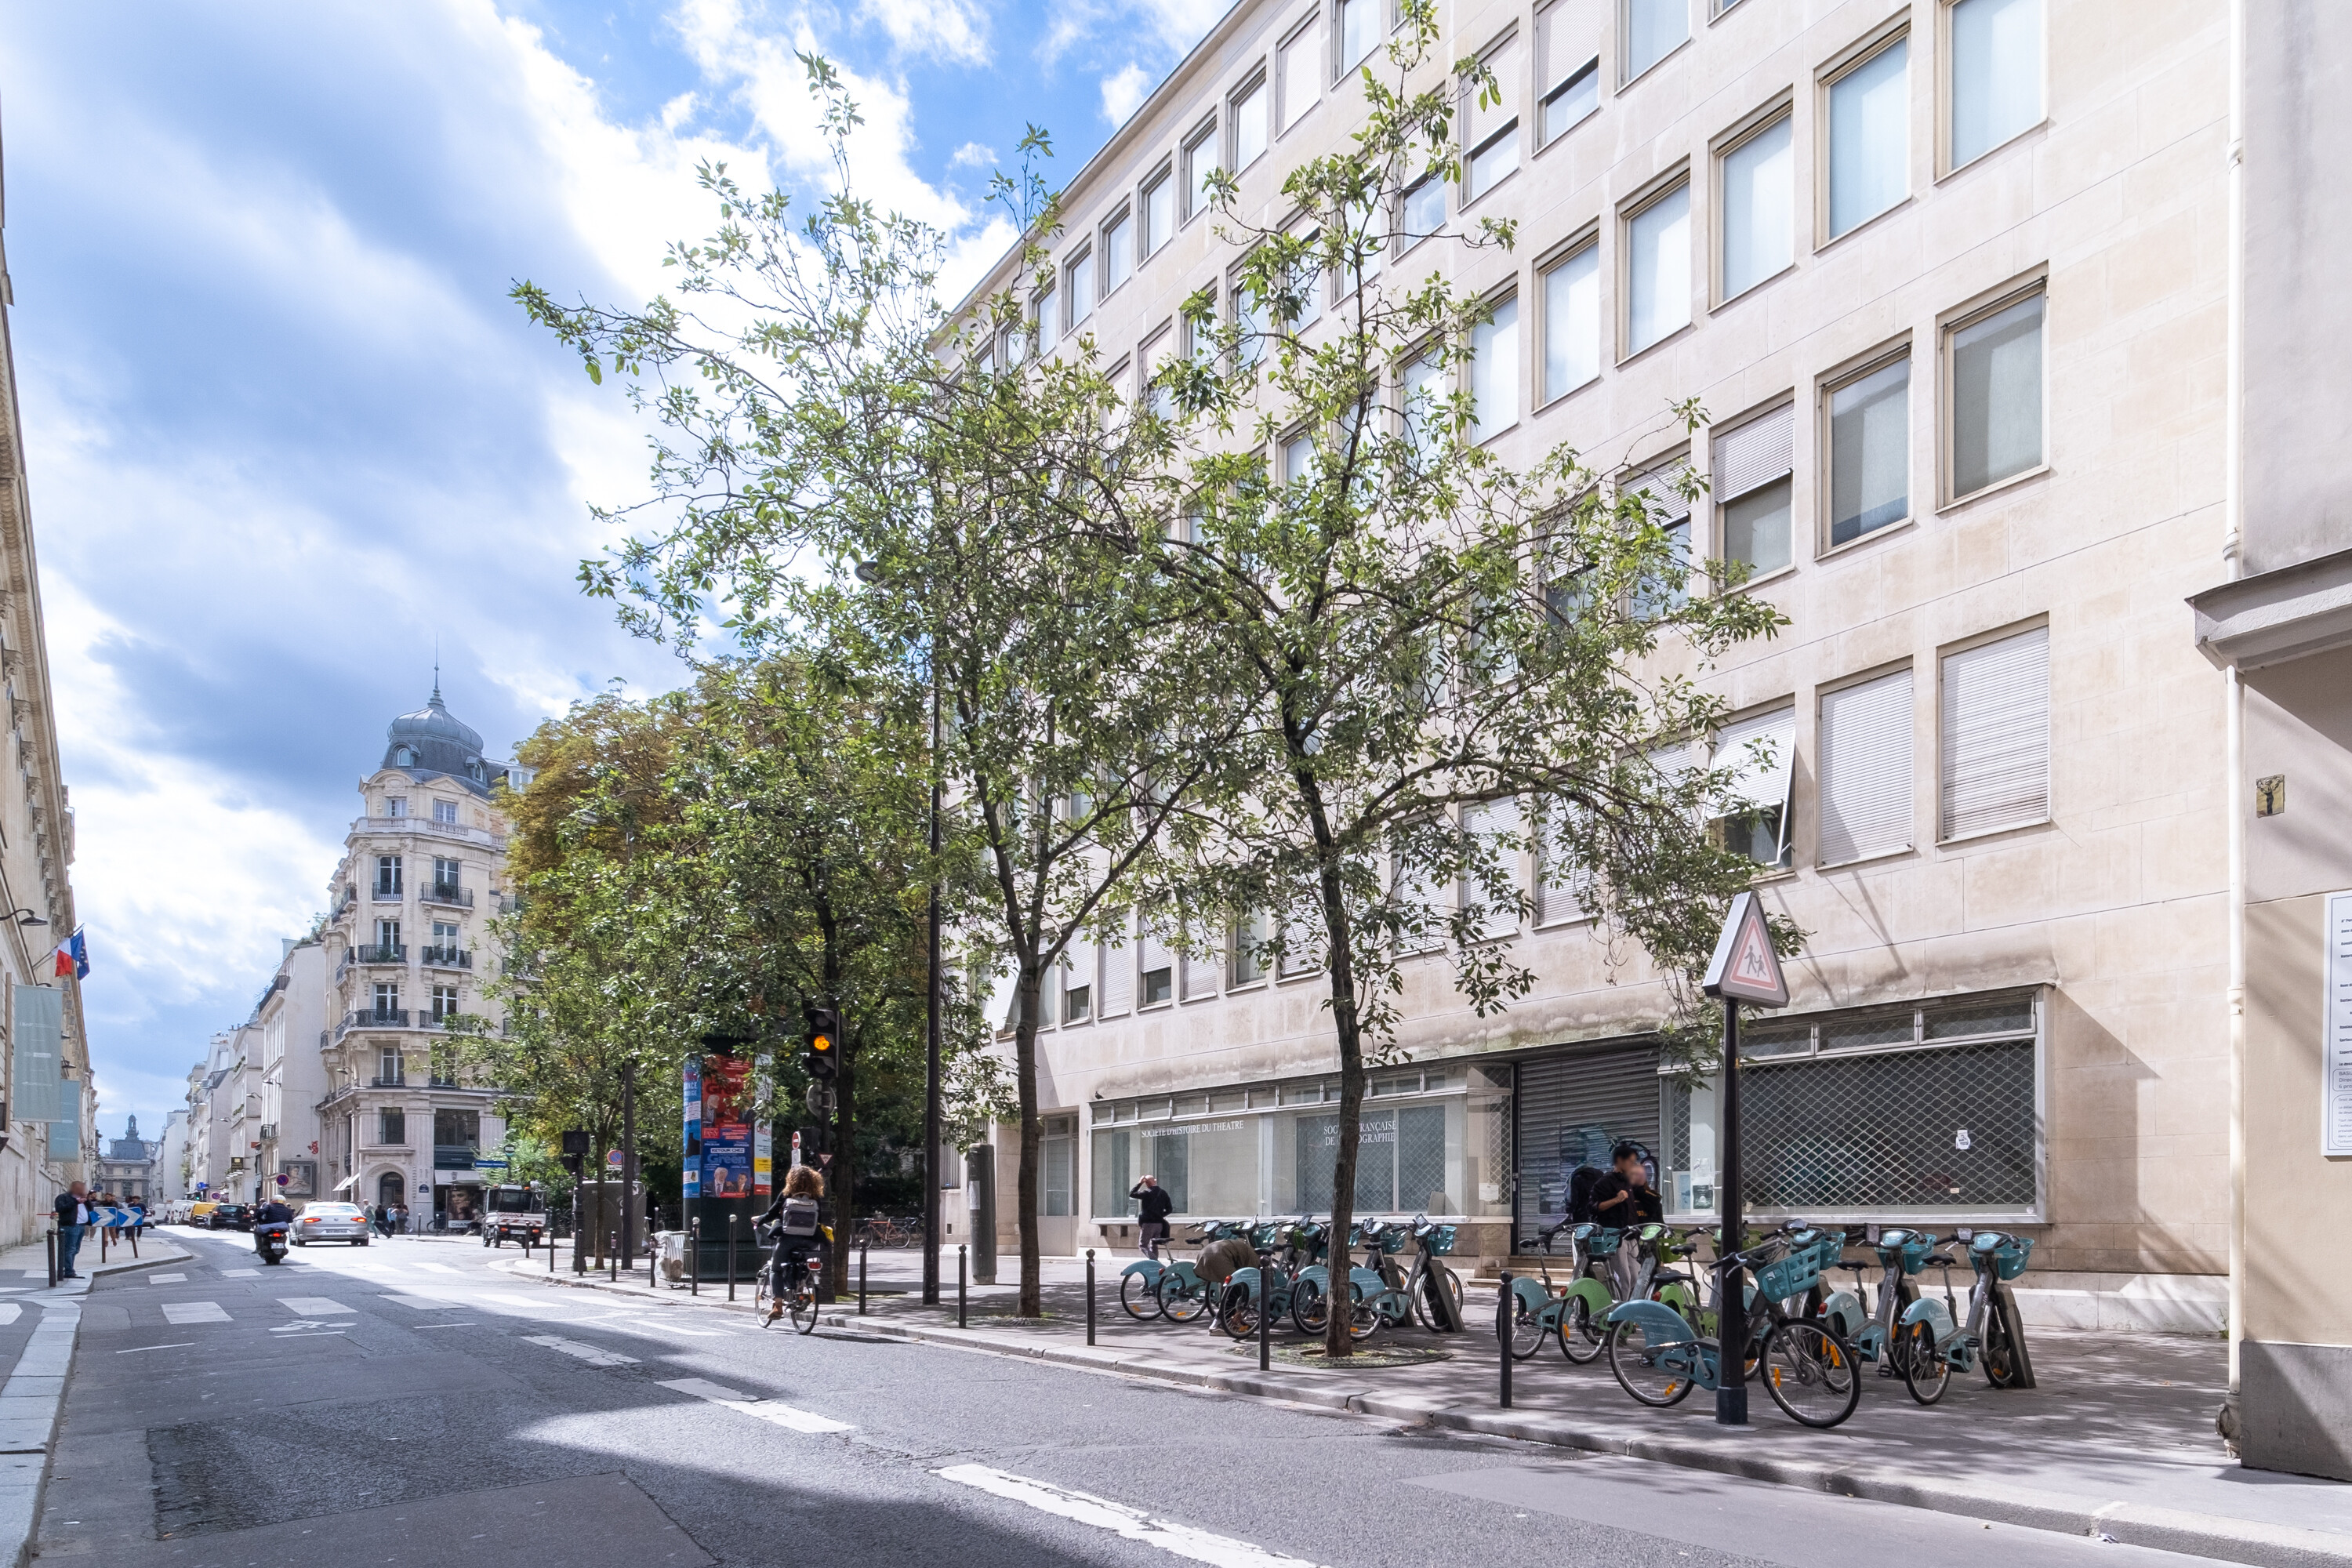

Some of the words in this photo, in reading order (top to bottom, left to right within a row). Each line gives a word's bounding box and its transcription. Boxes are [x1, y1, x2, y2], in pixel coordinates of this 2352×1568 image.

[1167, 1124, 1200, 1136] D'HISTOIRE
[1202, 1123, 1211, 1132] DU
[1212, 1120, 1244, 1131] THÉÂTRE
[1359, 1120, 1397, 1133] RANÇAISE
[1325, 1137, 1335, 1145] DE
[1358, 1133, 1395, 1144] OGRAPHIE
[707, 1154, 746, 1164] Green
